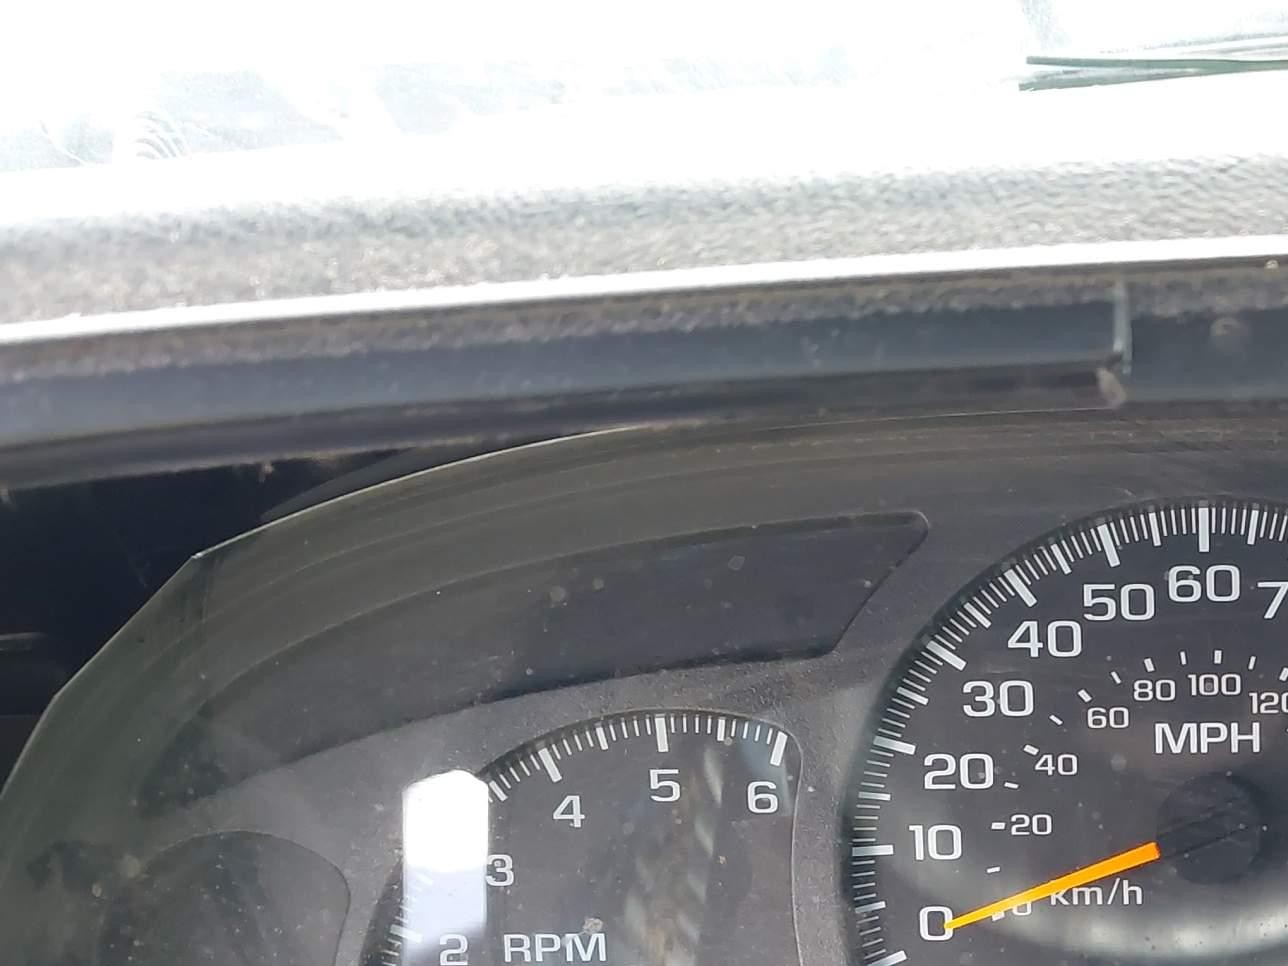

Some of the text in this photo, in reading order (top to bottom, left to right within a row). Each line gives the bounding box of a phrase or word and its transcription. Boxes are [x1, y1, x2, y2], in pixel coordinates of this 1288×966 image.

[1168, 564, 1240, 603] 60
[1083, 583, 1155, 621] 50
[1007, 620, 1082, 658] 40
[963, 680, 1034, 717] 30
[1133, 679, 1176, 701] 80
[1187, 673, 1241, 696] 100
[1087, 707, 1129, 729] 60
[1155, 722, 1260, 754] MPH
[924, 753, 994, 790] 20
[1034, 753, 1078, 776] 40
[649, 769, 681, 802] 5
[747, 781, 778, 814] 6
[552, 795, 586, 828] 4
[1010, 814, 1052, 836] 20
[908, 824, 962, 861] 10
[486, 854, 514, 887] 3
[1050, 878, 1143, 906] km/h
[919, 906, 954, 941] 0
[438, 933, 468, 966] 2
[503, 932, 607, 963] RPM
